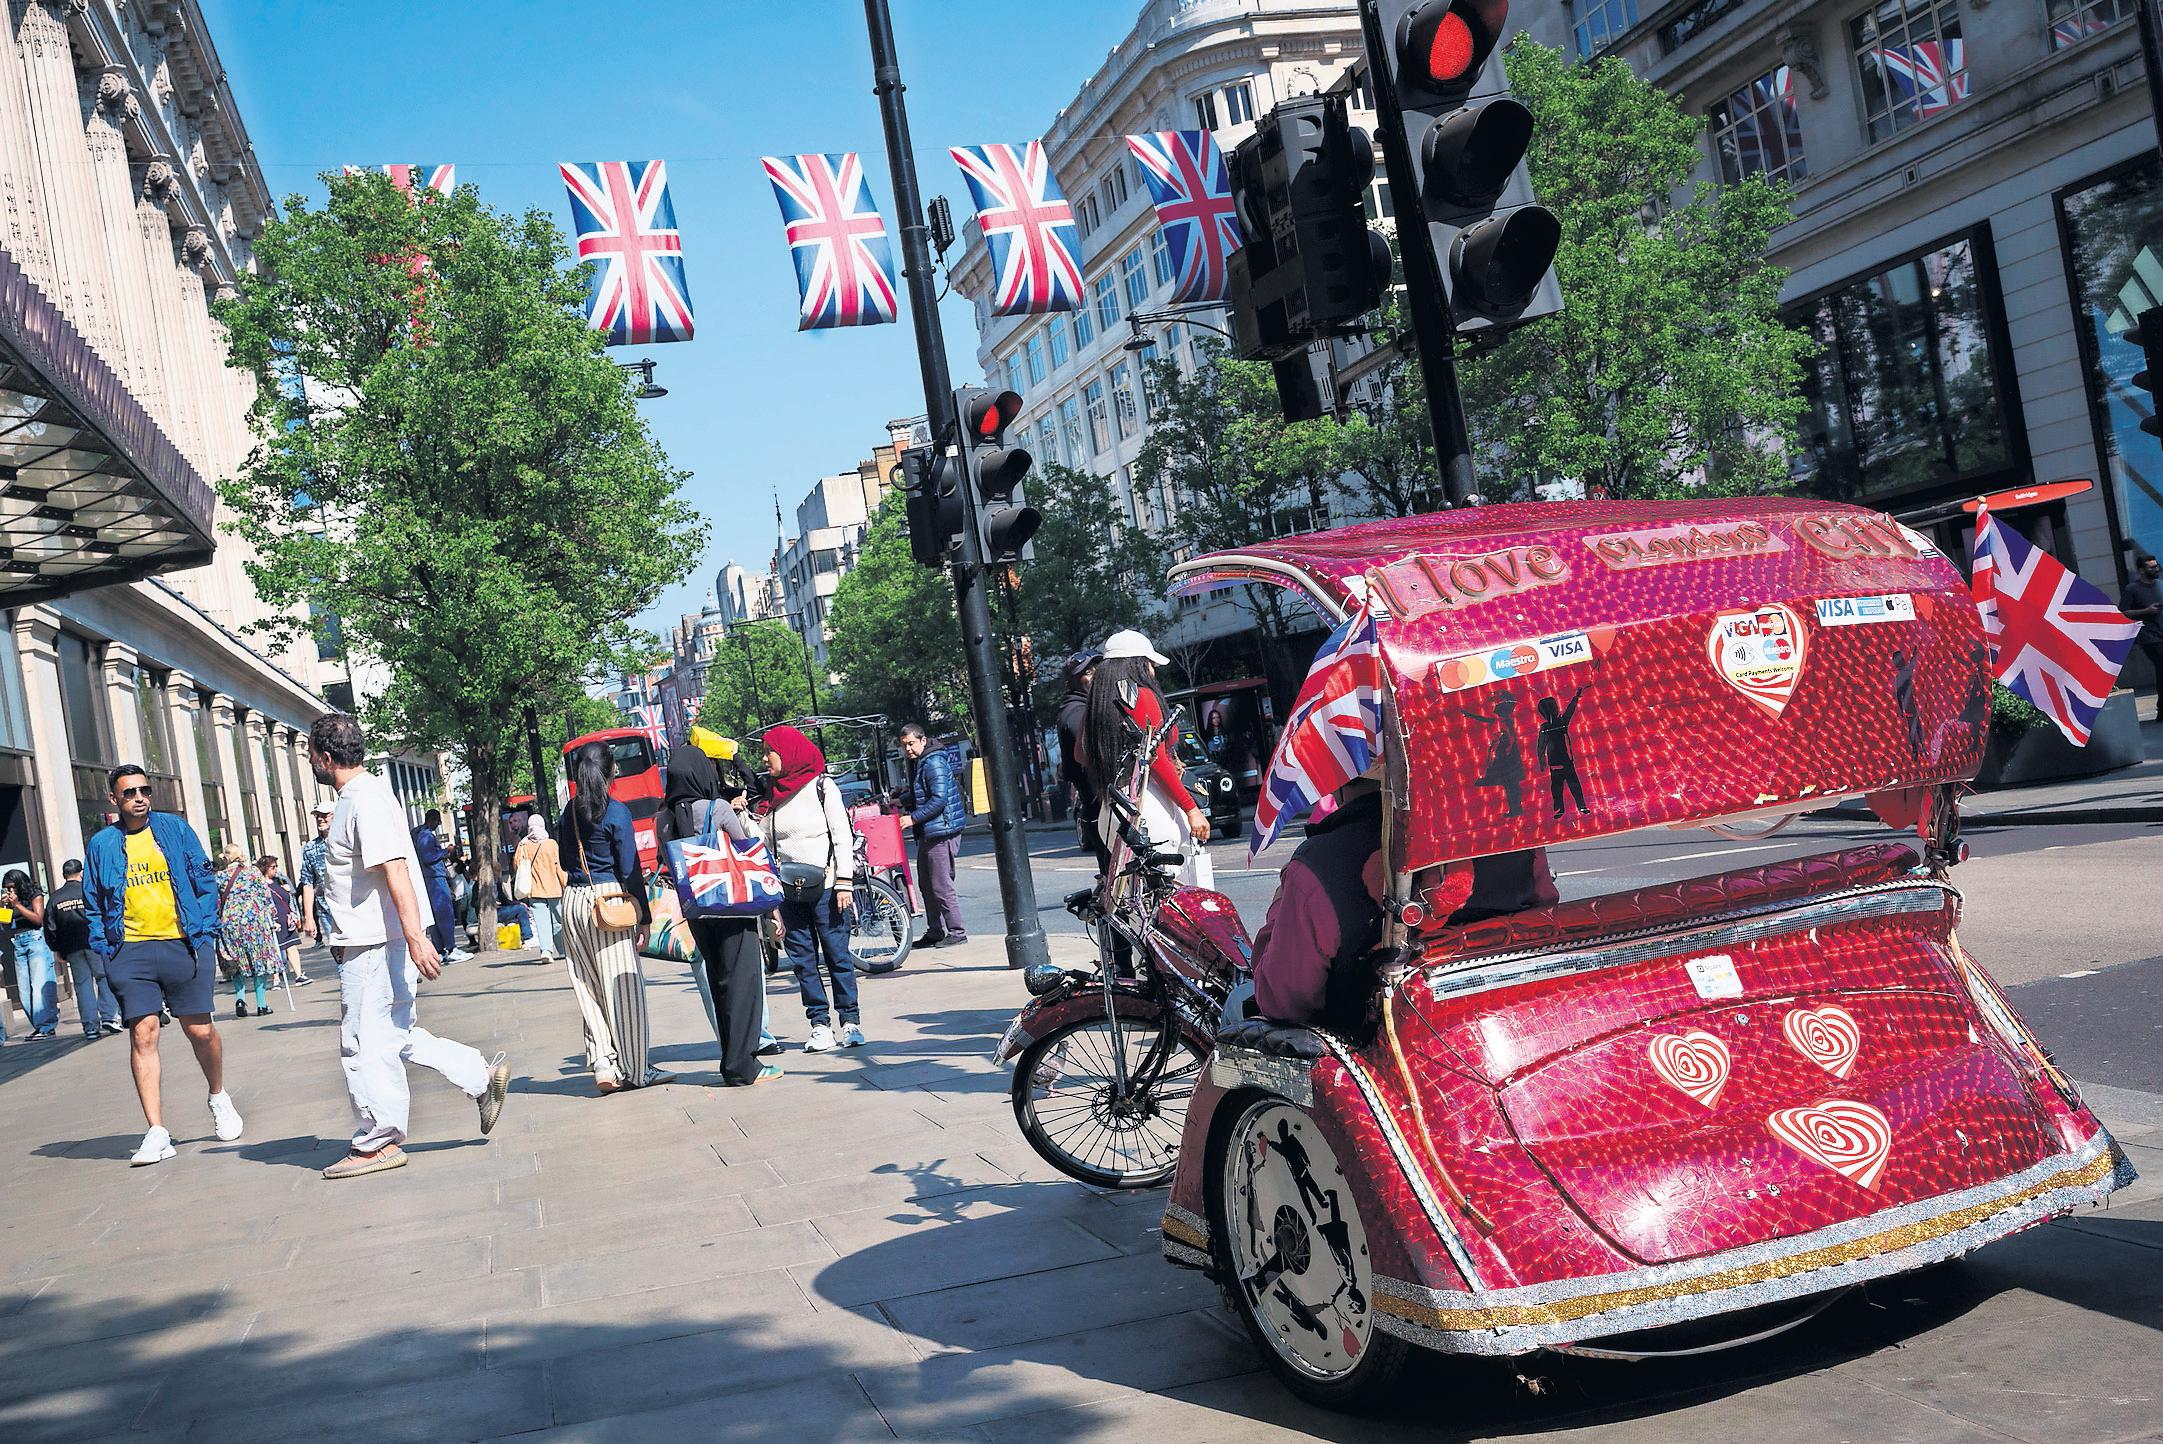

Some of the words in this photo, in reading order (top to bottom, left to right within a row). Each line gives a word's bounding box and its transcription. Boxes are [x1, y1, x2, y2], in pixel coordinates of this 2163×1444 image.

[1415, 546, 1567, 604] love
[1817, 599, 1855, 618] VISA
[1548, 640, 1584, 658] VISA
[1495, 653, 1536, 670] Maestro
[1748, 668, 1773, 677] Payments
[1773, 665, 1794, 674] Welcome
[130, 862, 149, 873] Fly
